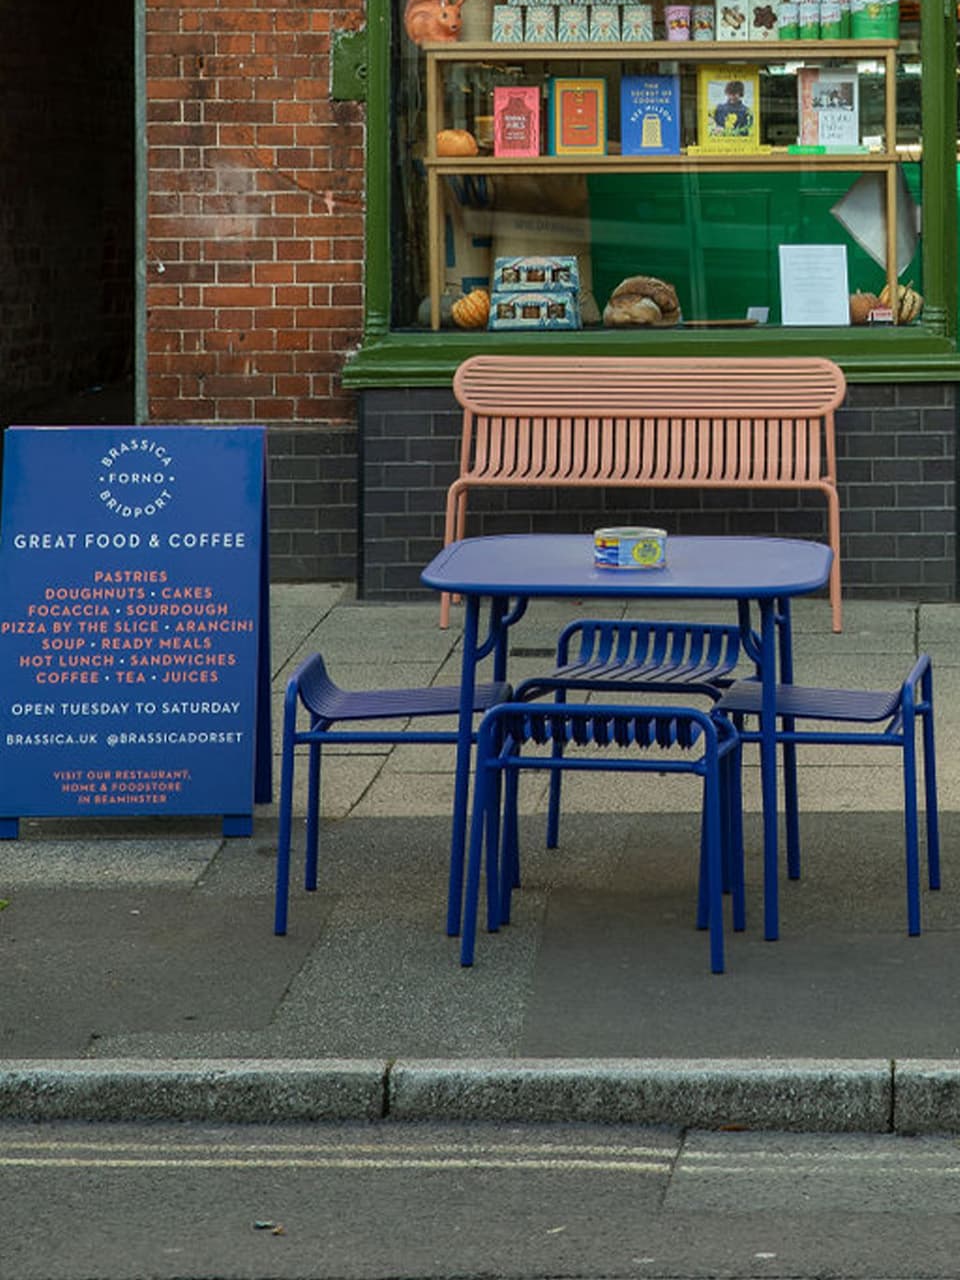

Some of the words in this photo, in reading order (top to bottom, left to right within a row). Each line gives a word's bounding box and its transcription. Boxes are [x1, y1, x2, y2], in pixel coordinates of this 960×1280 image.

[101, 439, 173, 468] BRASSICA
[109, 473, 164, 484] FORNO
[100, 489, 172, 518] BRIDPORT
[14, 534, 76, 548] GREAT
[85, 534, 140, 548] FOOD
[149, 534, 160, 548] &
[169, 533, 245, 548] COFFEE
[94, 571, 168, 582] PASTRIES
[45, 588, 145, 600] DOUGHNUTS
[161, 587, 213, 599] CAKES
[28, 605, 110, 617] FOCACCIA
[126, 604, 228, 616] SOURDOUGH
[1, 622, 47, 634] PIZZA
[53, 622, 72, 633] BY
[79, 622, 108, 633] THE
[114, 622, 159, 633] SLICE
[175, 620, 254, 632] ARANCINI
[41, 638, 86, 650] SOUP
[101, 638, 153, 649] READY
[159, 637, 212, 649] MEALS
[19, 656, 53, 667] HOT
[59, 655, 114, 667] LUNCH
[130, 654, 236, 666] SANDWICHES
[36, 672, 99, 684] COFFEE
[116, 672, 146, 683] TEA
[162, 671, 219, 683] JUICES
[11, 704, 55, 716] OPEN
[61, 703, 129, 715] TUESDAY
[136, 703, 156, 714] TO
[161, 702, 241, 714] SATURDAY
[6, 734, 98, 746] BRASSICA.UK
[106, 732, 244, 747] @BRASSICADORSET
[87, 770, 111, 780] OUR
